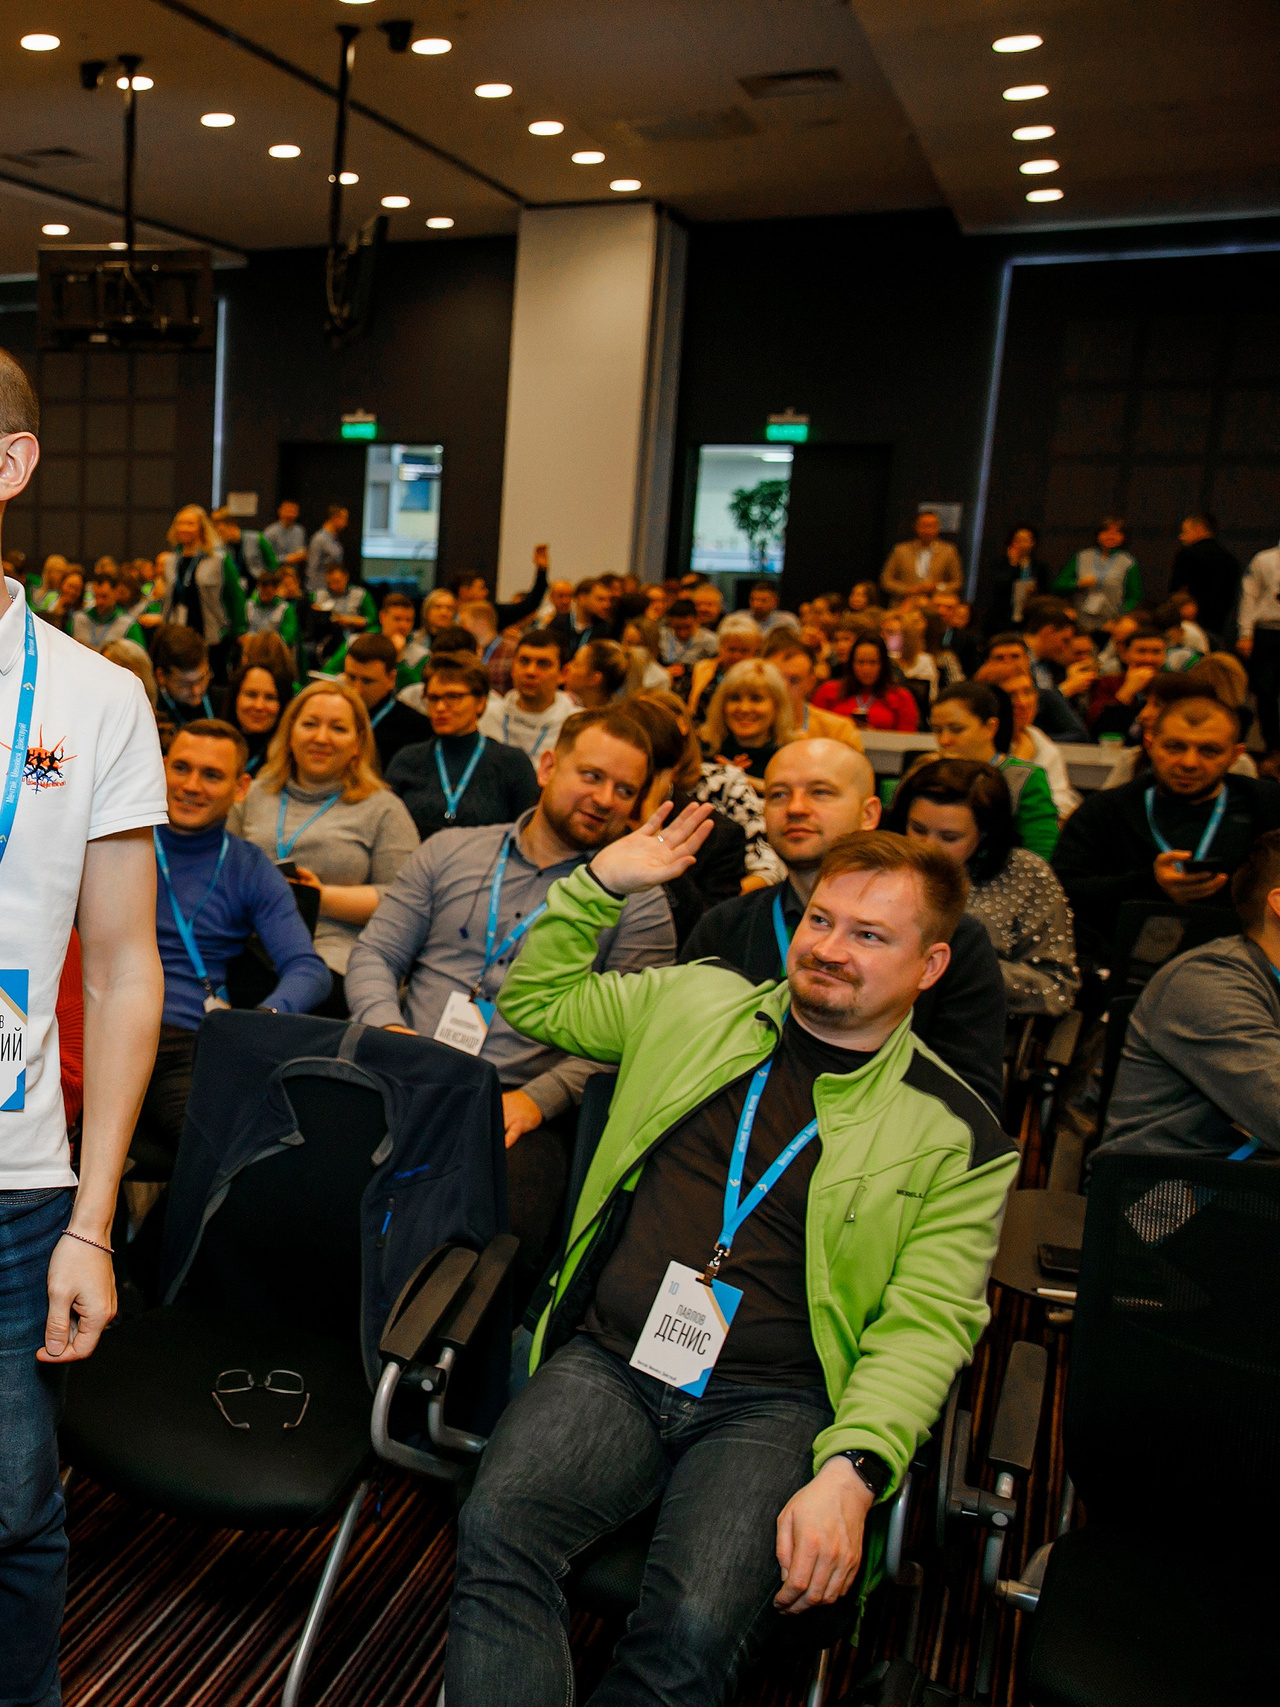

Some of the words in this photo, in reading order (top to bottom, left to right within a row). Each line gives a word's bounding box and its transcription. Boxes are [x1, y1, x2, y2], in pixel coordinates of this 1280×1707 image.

[668, 1281, 680, 1296] 10
[676, 1304, 706, 1325] ПАВЛОВ
[654, 1314, 711, 1355] ДЕНИС
